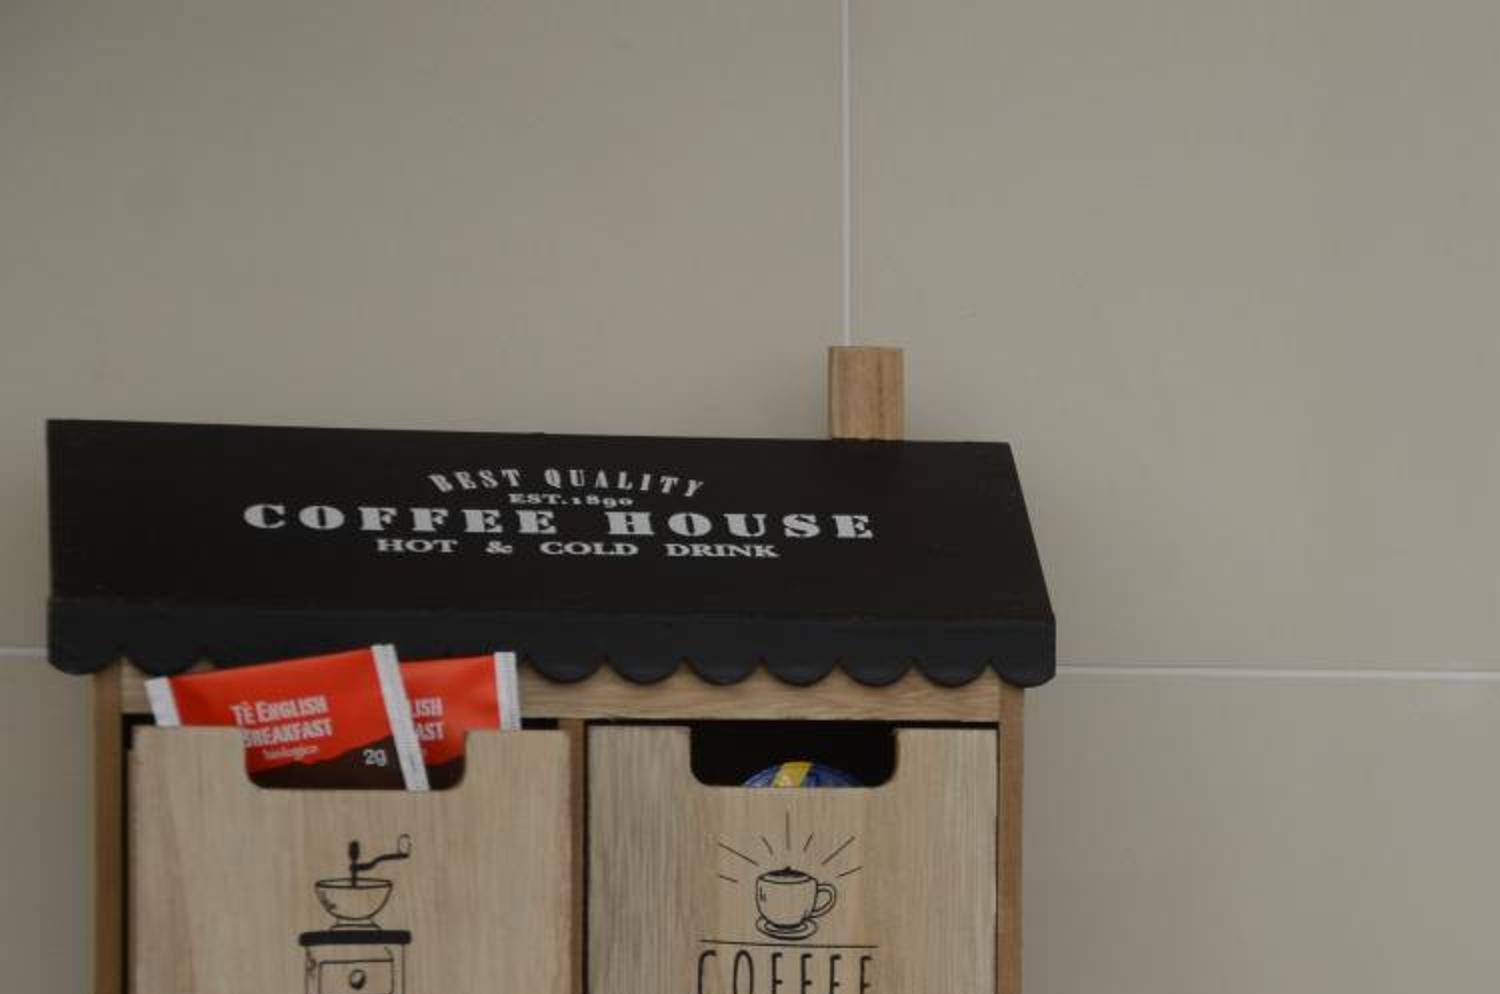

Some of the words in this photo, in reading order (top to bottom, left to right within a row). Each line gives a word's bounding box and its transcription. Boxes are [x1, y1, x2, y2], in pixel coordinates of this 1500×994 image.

[427, 468, 520, 493] BEST
[543, 468, 704, 498] QUALITY
[243, 503, 558, 534] COFFEE
[604, 511, 874, 539] HOUSE
[376, 538, 459, 553] HOT
[485, 541, 513, 555] &
[539, 540, 639, 556] COLD
[665, 543, 781, 558] DRINK
[362, 747, 388, 768] 2g
